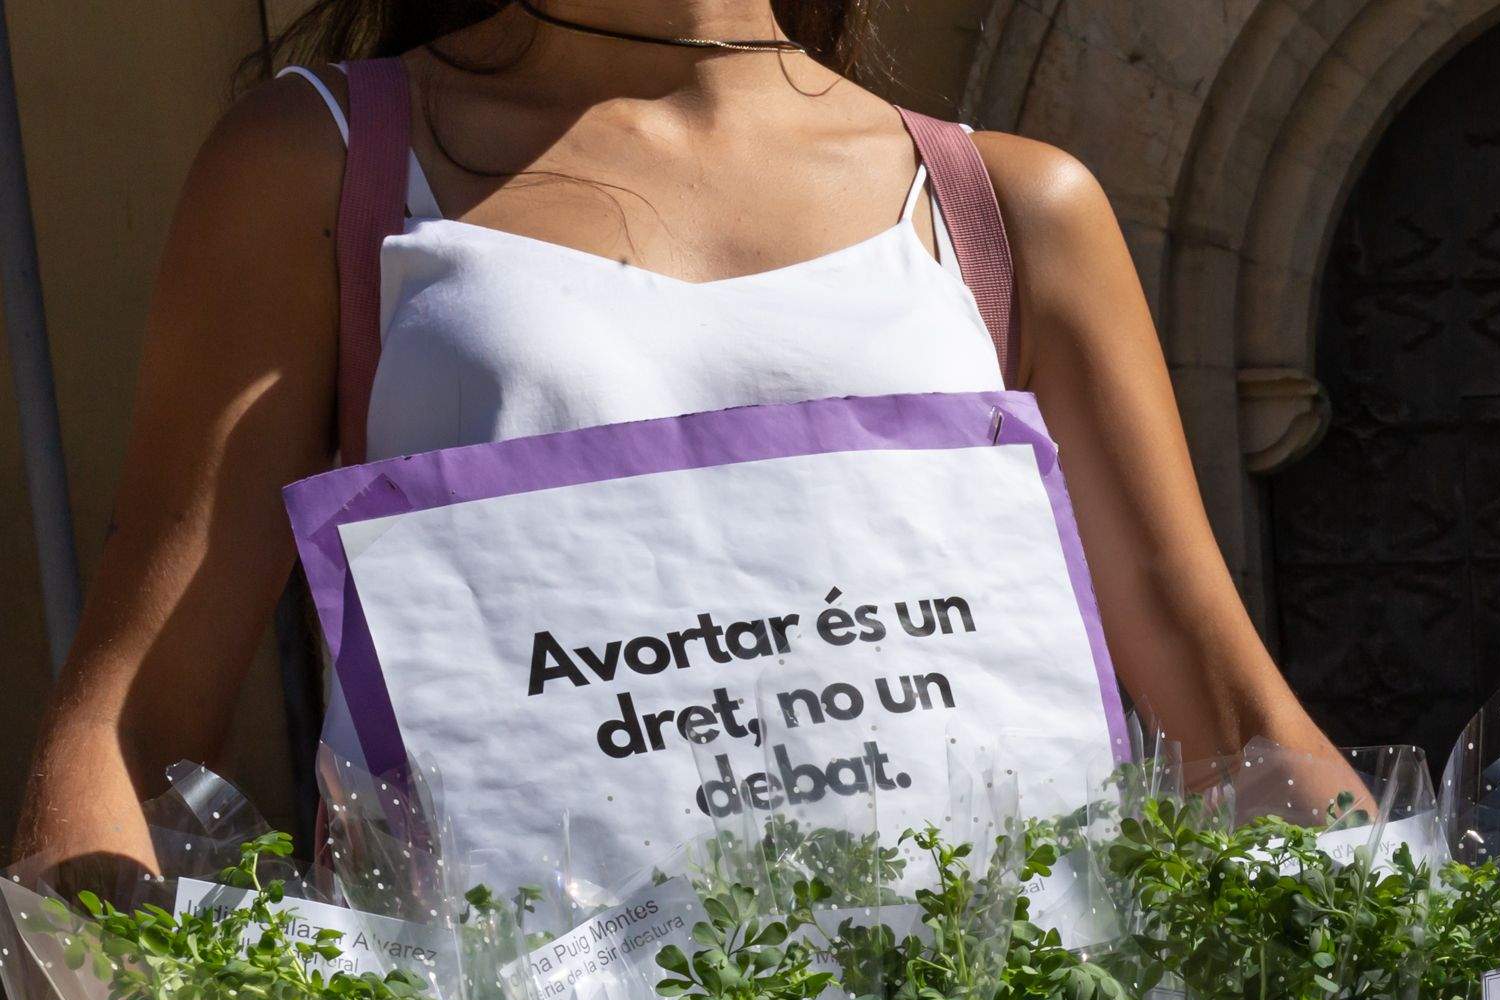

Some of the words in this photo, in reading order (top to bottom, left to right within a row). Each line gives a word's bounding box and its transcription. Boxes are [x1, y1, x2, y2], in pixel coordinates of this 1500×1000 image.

[527, 611, 800, 697] Avortar
[816, 585, 887, 646] és
[894, 594, 977, 638] un
[596, 686, 767, 760] dret,
[776, 680, 865, 729] no
[875, 671, 957, 714] un
[695, 740, 913, 819] debat.
[553, 935, 591, 964] Puig
[589, 898, 660, 944] Montes
[567, 967, 583, 986] de
[584, 959, 598, 977] la
